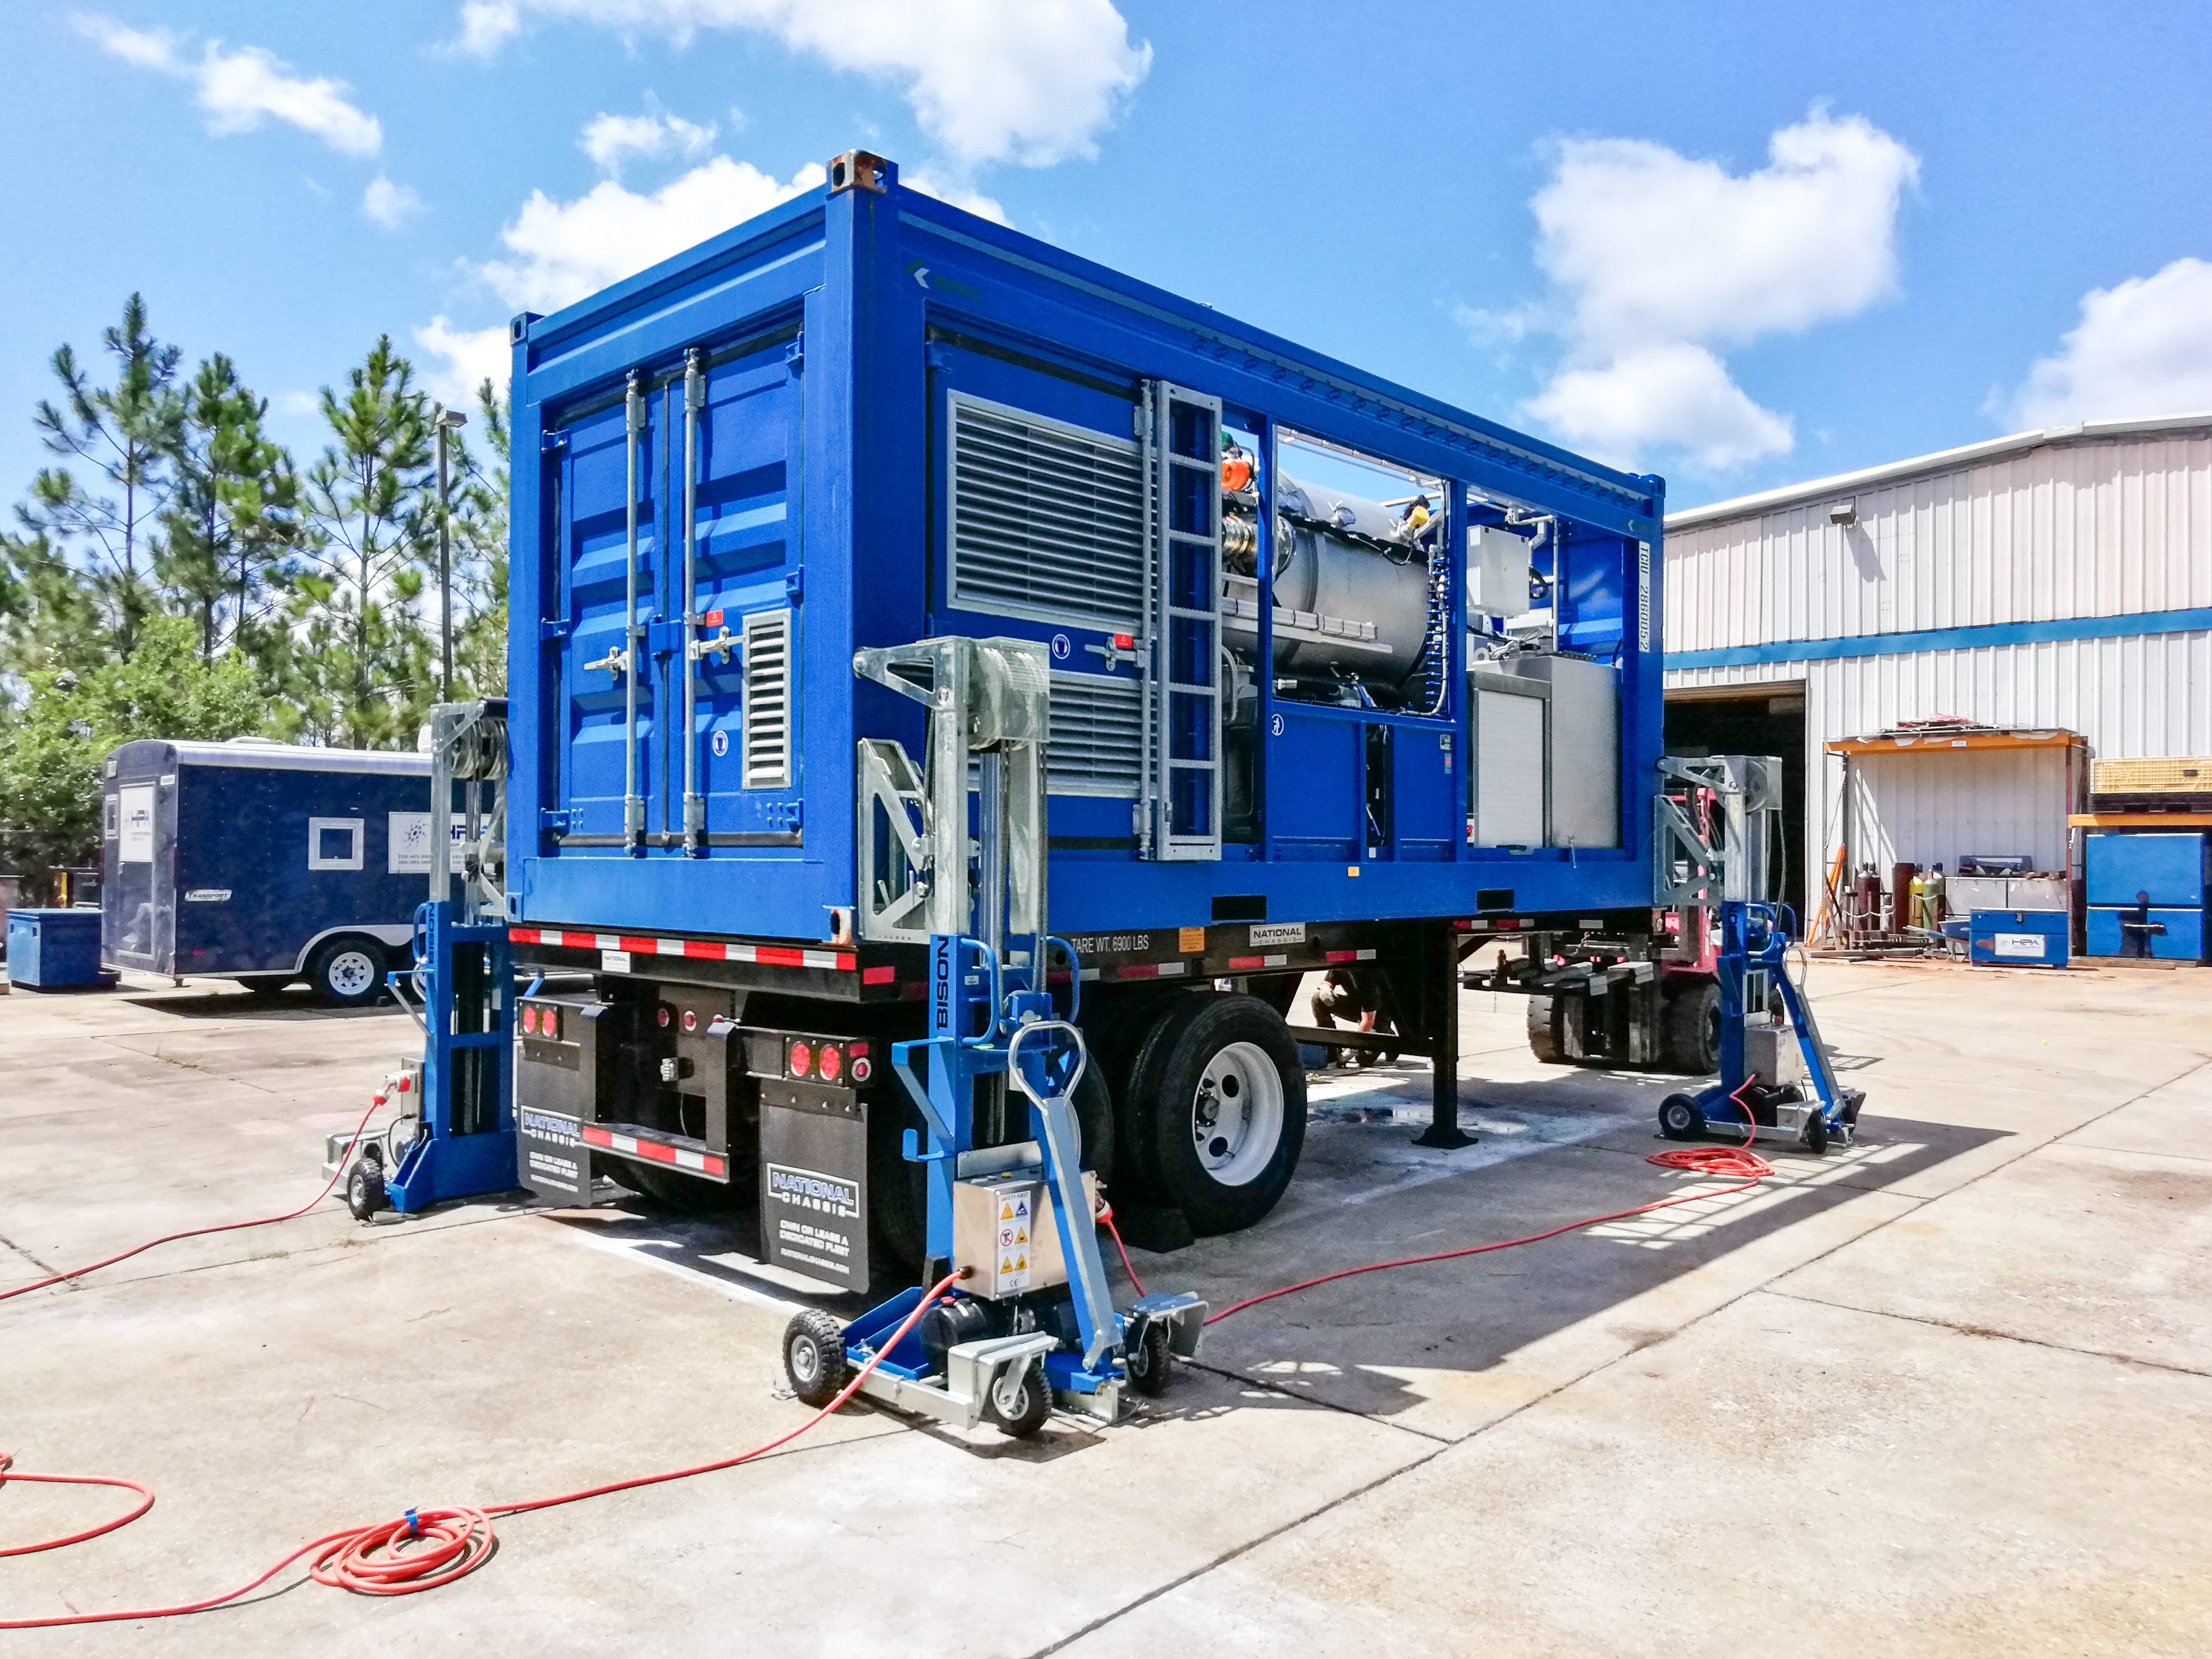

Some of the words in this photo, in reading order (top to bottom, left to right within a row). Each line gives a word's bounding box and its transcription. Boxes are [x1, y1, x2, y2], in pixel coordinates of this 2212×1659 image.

[1071, 937, 1094, 953] TARE
[1096, 936, 1111, 952] WT.
[1112, 936, 1132, 951] 6900
[1133, 935, 1149, 950] LBS
[1253, 927, 1301, 938] NATIONAL
[936, 936, 949, 1030] BISON
[524, 1112, 581, 1137] NATIONAL
[772, 1171, 854, 1206] NATIONAL
[782, 1191, 847, 1218] CHASSIS
[780, 1219, 801, 1232] OWN
[801, 1225, 814, 1236] OR
[841, 1236, 849, 1246] A
